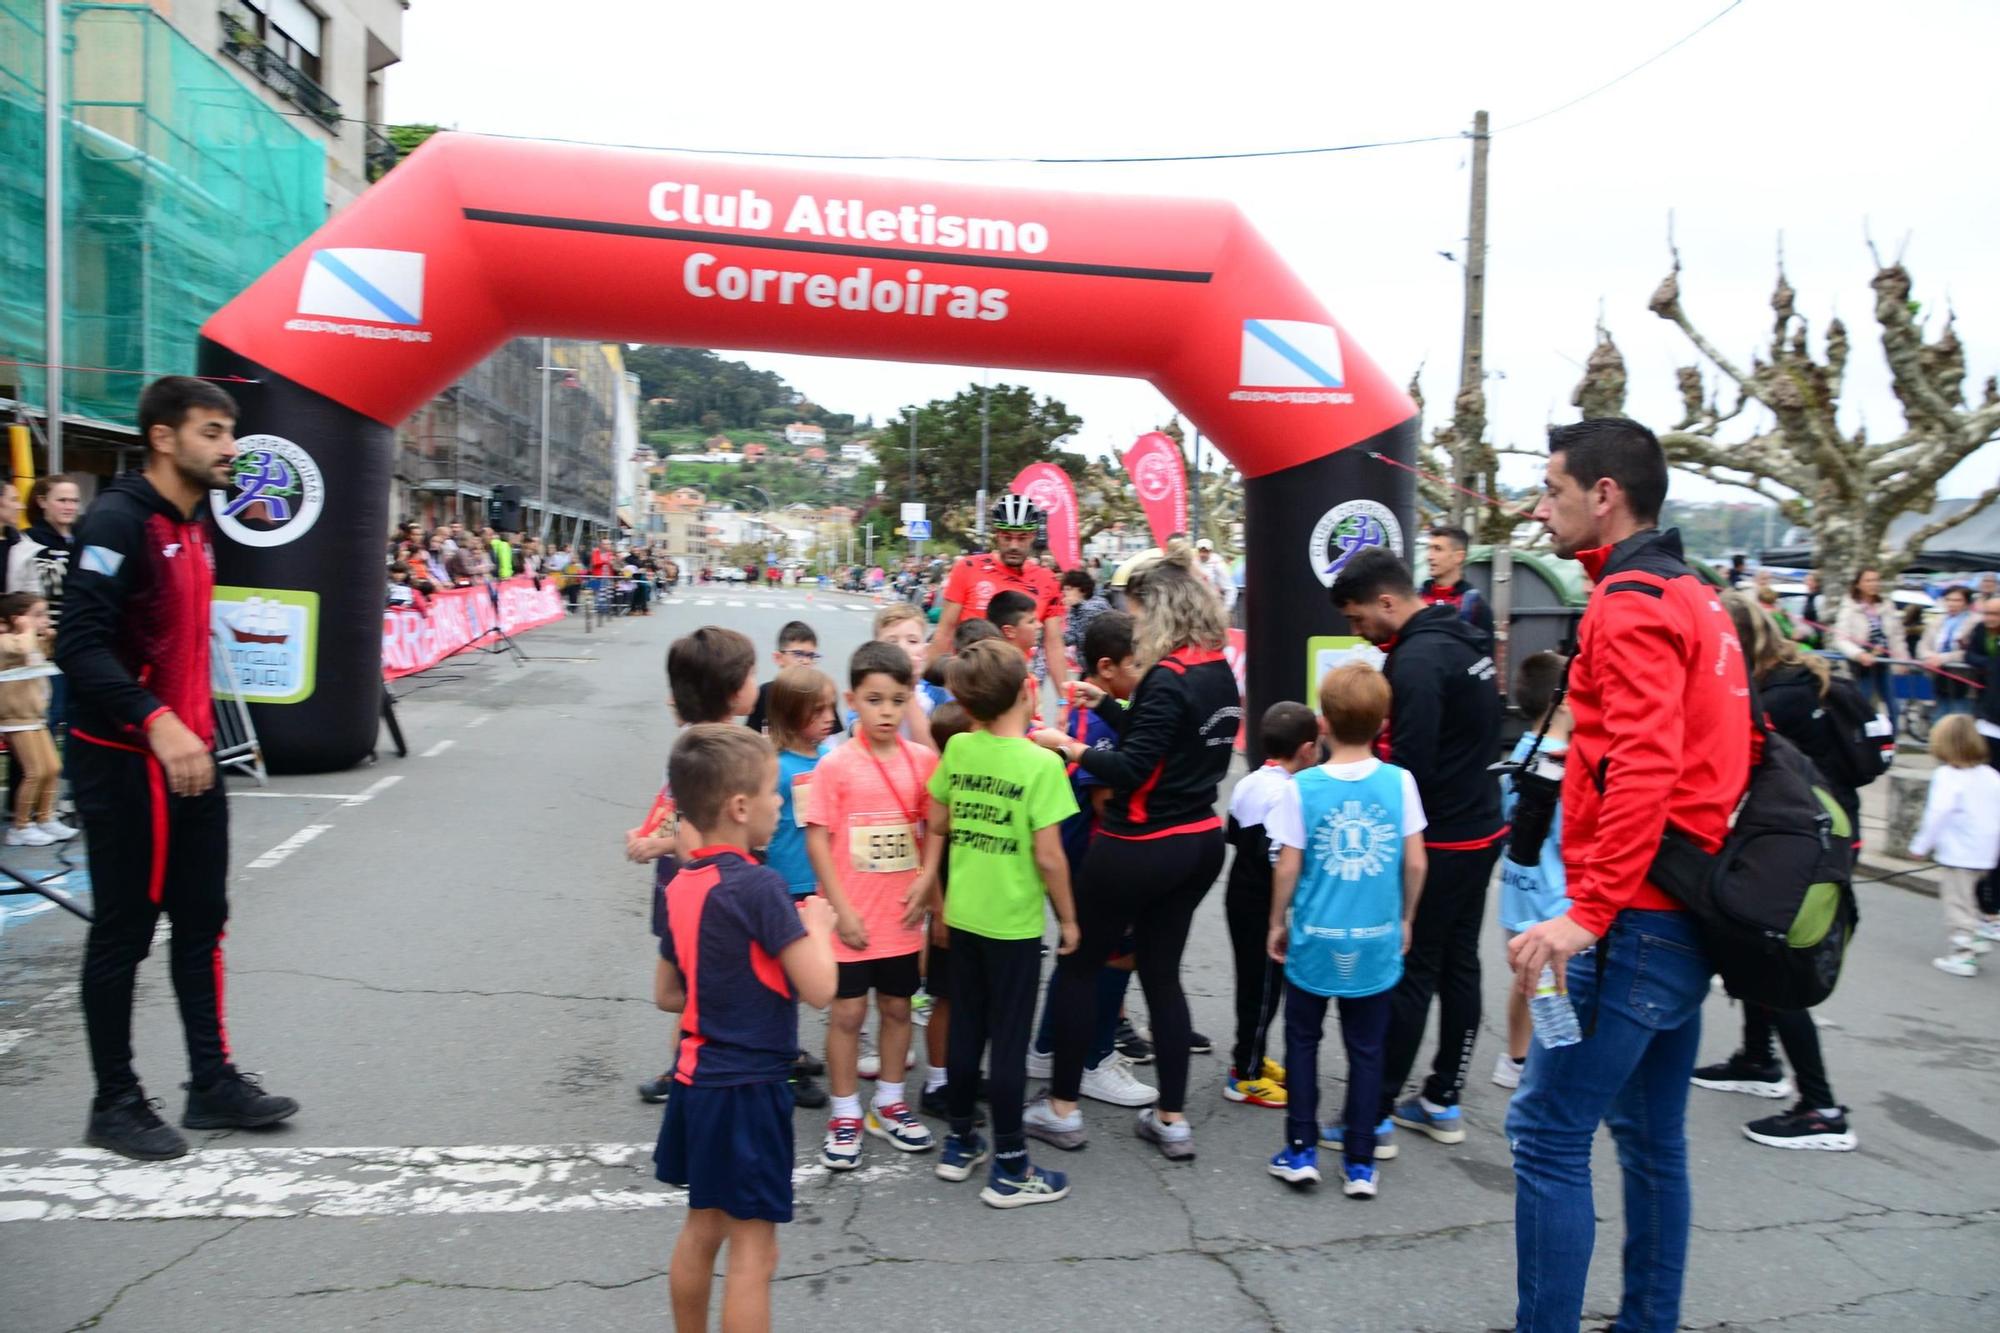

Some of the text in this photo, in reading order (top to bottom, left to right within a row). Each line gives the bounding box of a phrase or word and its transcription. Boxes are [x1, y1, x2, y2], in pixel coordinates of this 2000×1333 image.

[647, 181, 1049, 254] Club Atletismo
[683, 252, 1010, 321] Corredoiras
